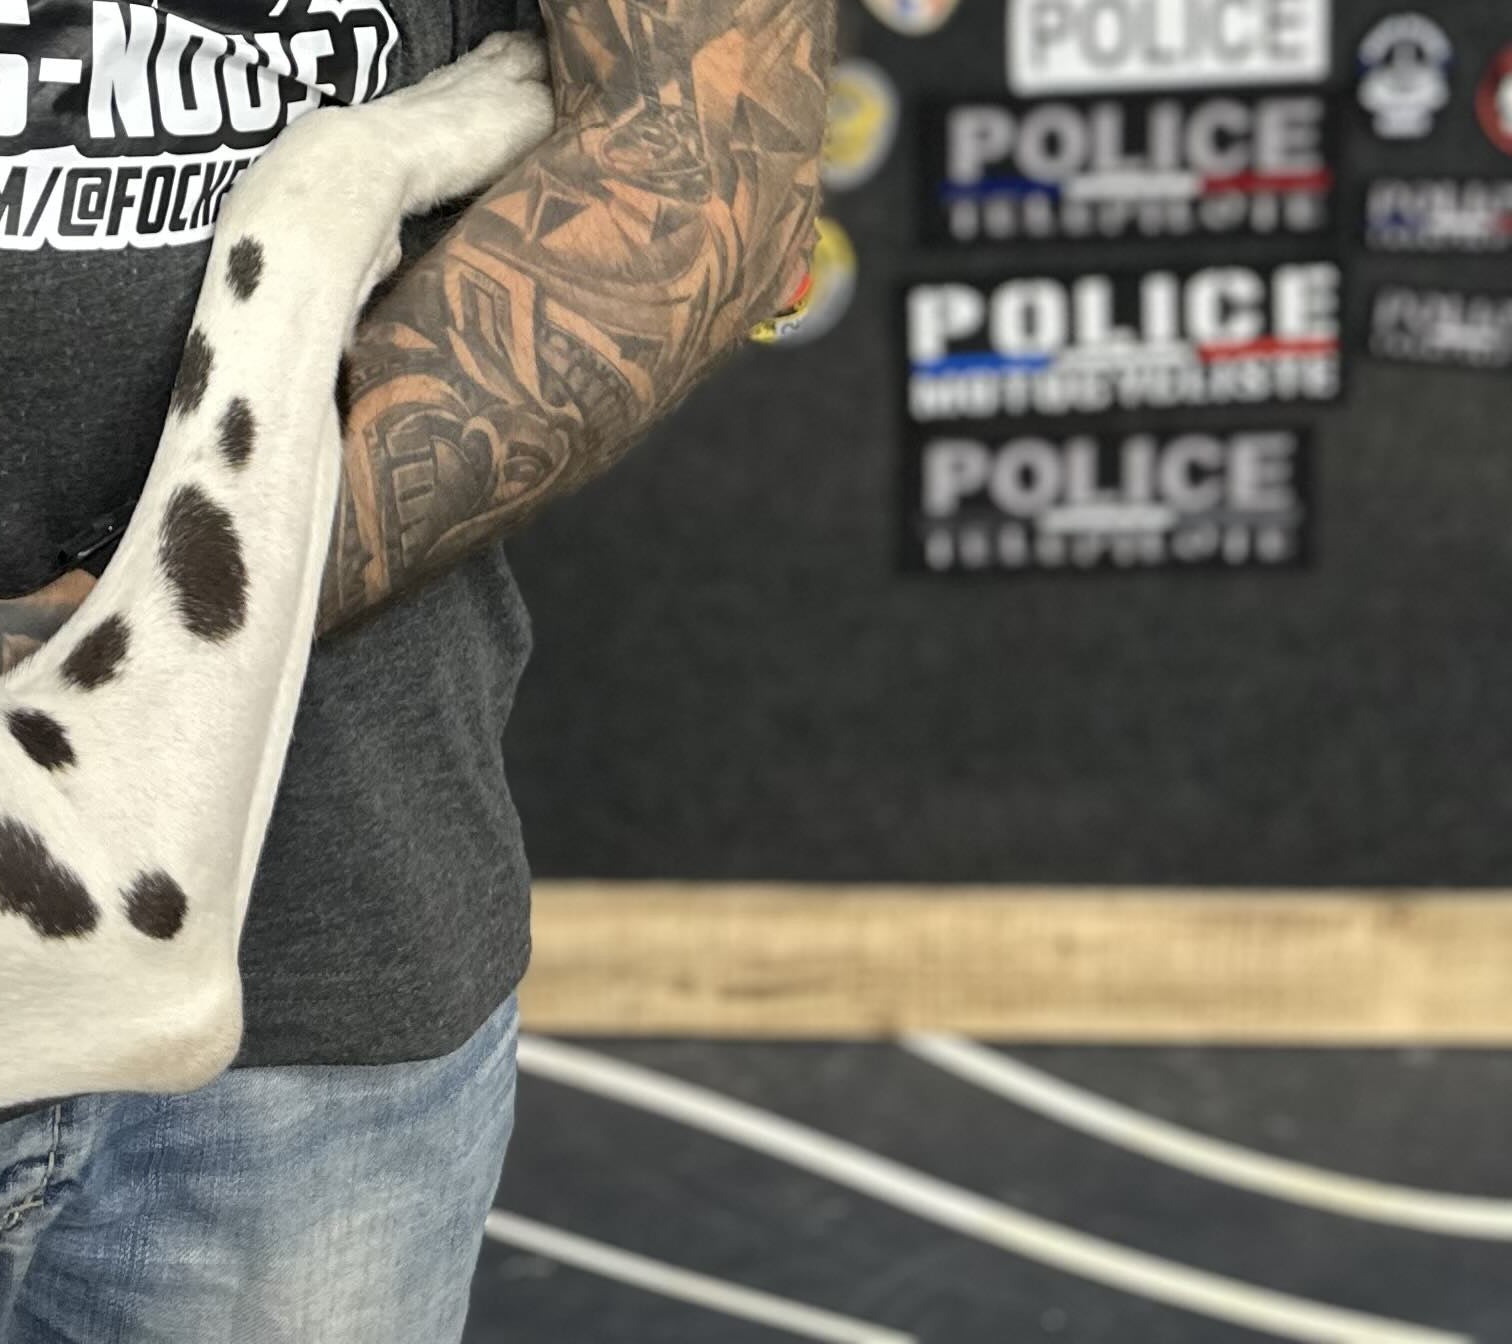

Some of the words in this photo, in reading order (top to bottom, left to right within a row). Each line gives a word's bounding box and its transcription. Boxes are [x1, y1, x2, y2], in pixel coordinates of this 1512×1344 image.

[945, 95, 1326, 184] POLICE
[906, 261, 1341, 362] POLICE
[922, 431, 1297, 518] POLICE
